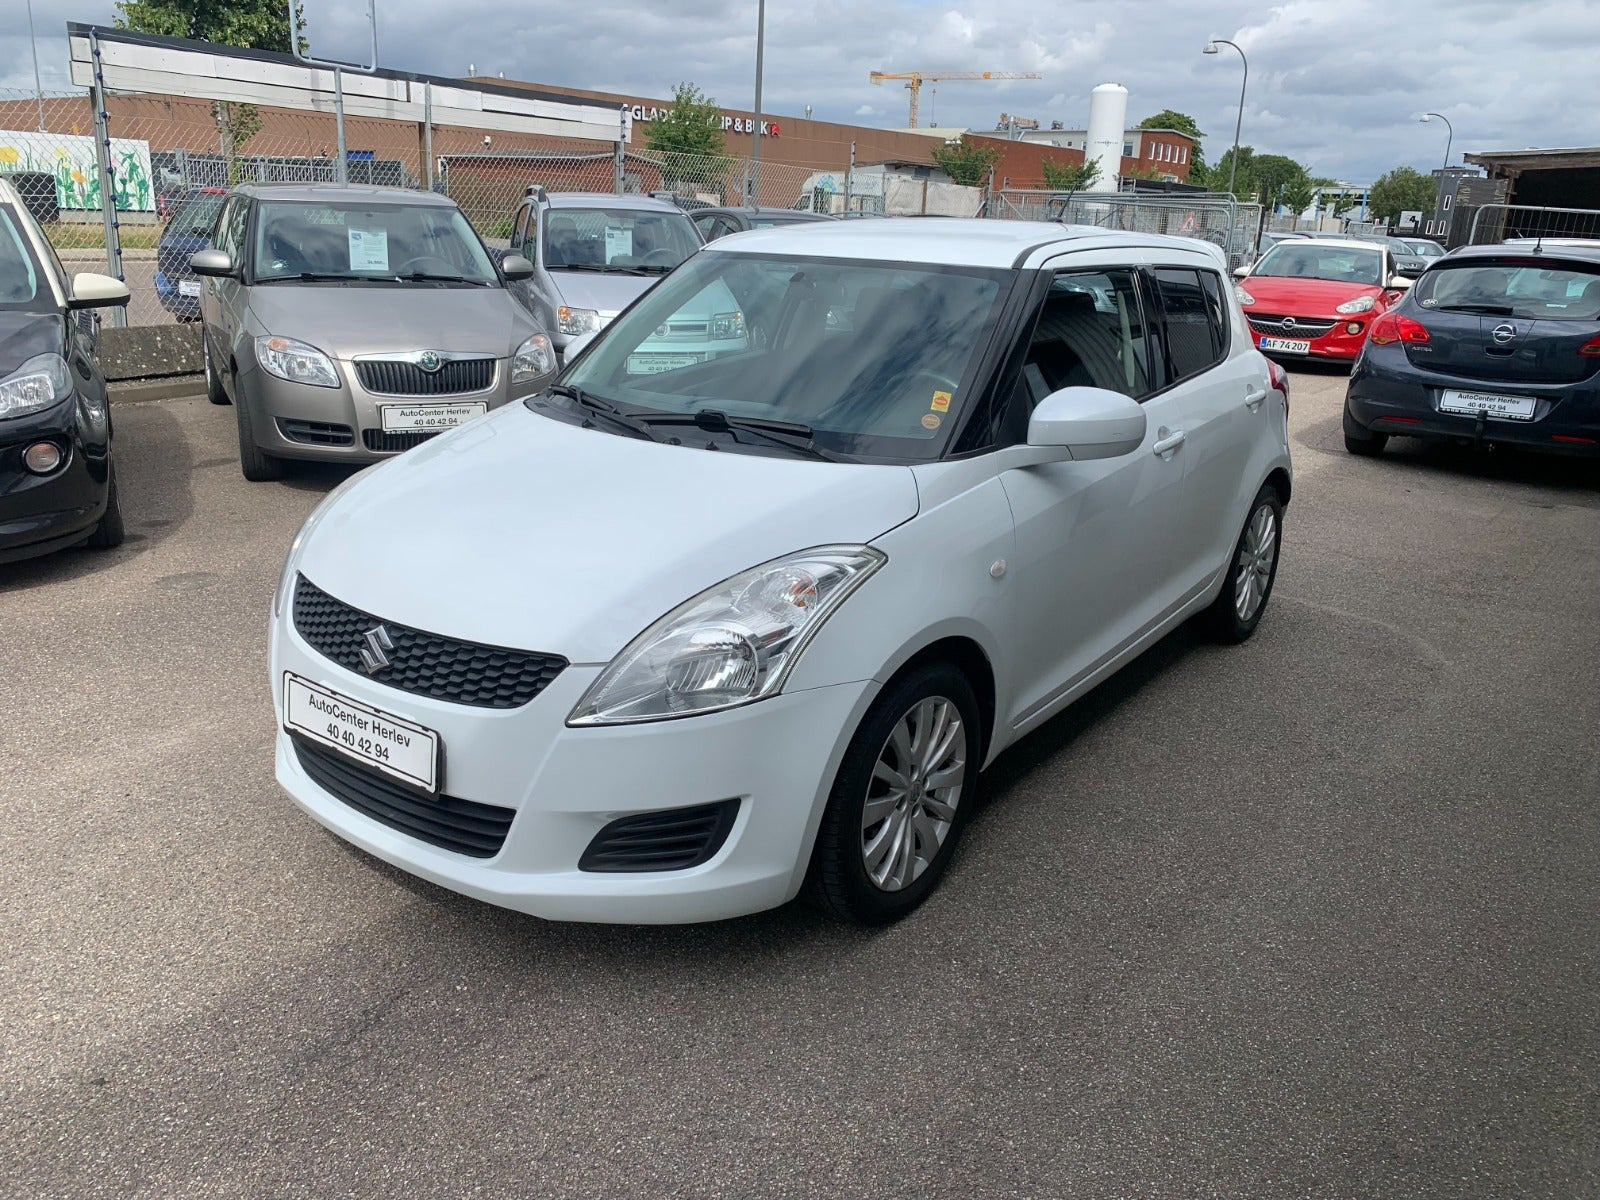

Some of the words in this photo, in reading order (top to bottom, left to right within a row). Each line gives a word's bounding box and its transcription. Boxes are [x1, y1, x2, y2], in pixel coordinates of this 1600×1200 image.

[734, 117, 743, 132] &
[1266, 339, 1278, 348] AF
[1279, 340, 1291, 350] 74
[1291, 342, 1309, 351] 207
[1457, 393, 1497, 403] AutoCenter
[1497, 396, 1521, 405] Herlev
[400, 409, 445, 417] AutoCenter
[446, 408, 471, 416] Herlev
[309, 693, 369, 731] AutoCenter
[372, 720, 411, 748] Herlev
[327, 722, 340, 739] 40
[341, 730, 355, 746] 40
[358, 737, 372, 754] 42
[374, 743, 390, 760] 94
